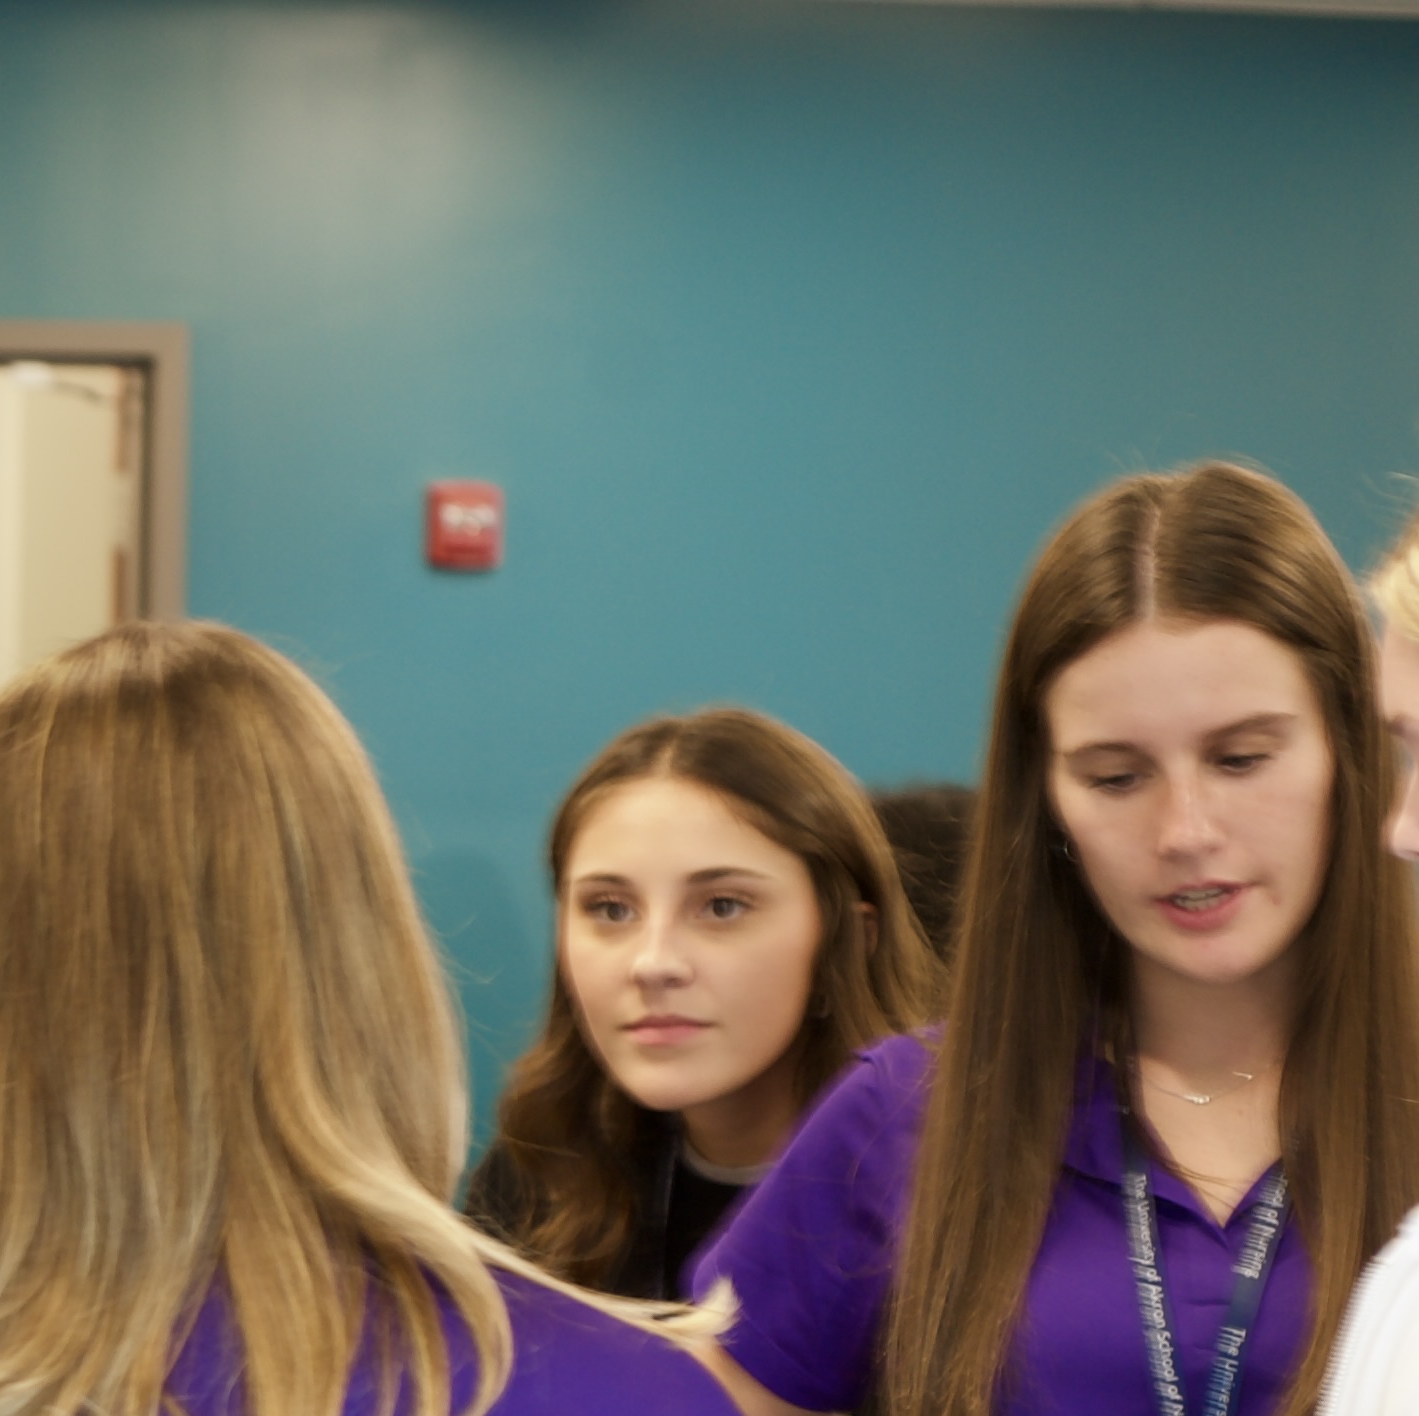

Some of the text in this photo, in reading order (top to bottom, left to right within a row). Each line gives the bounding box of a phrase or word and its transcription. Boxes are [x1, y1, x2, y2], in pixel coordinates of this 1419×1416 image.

[1129, 1173, 1149, 1200] The
[1131, 1200, 1157, 1267] University
[1238, 1222, 1277, 1280] Nursing
[1145, 1284, 1168, 1329] Akron
[1152, 1330, 1177, 1382] School
[1220, 1324, 1247, 1357] The
